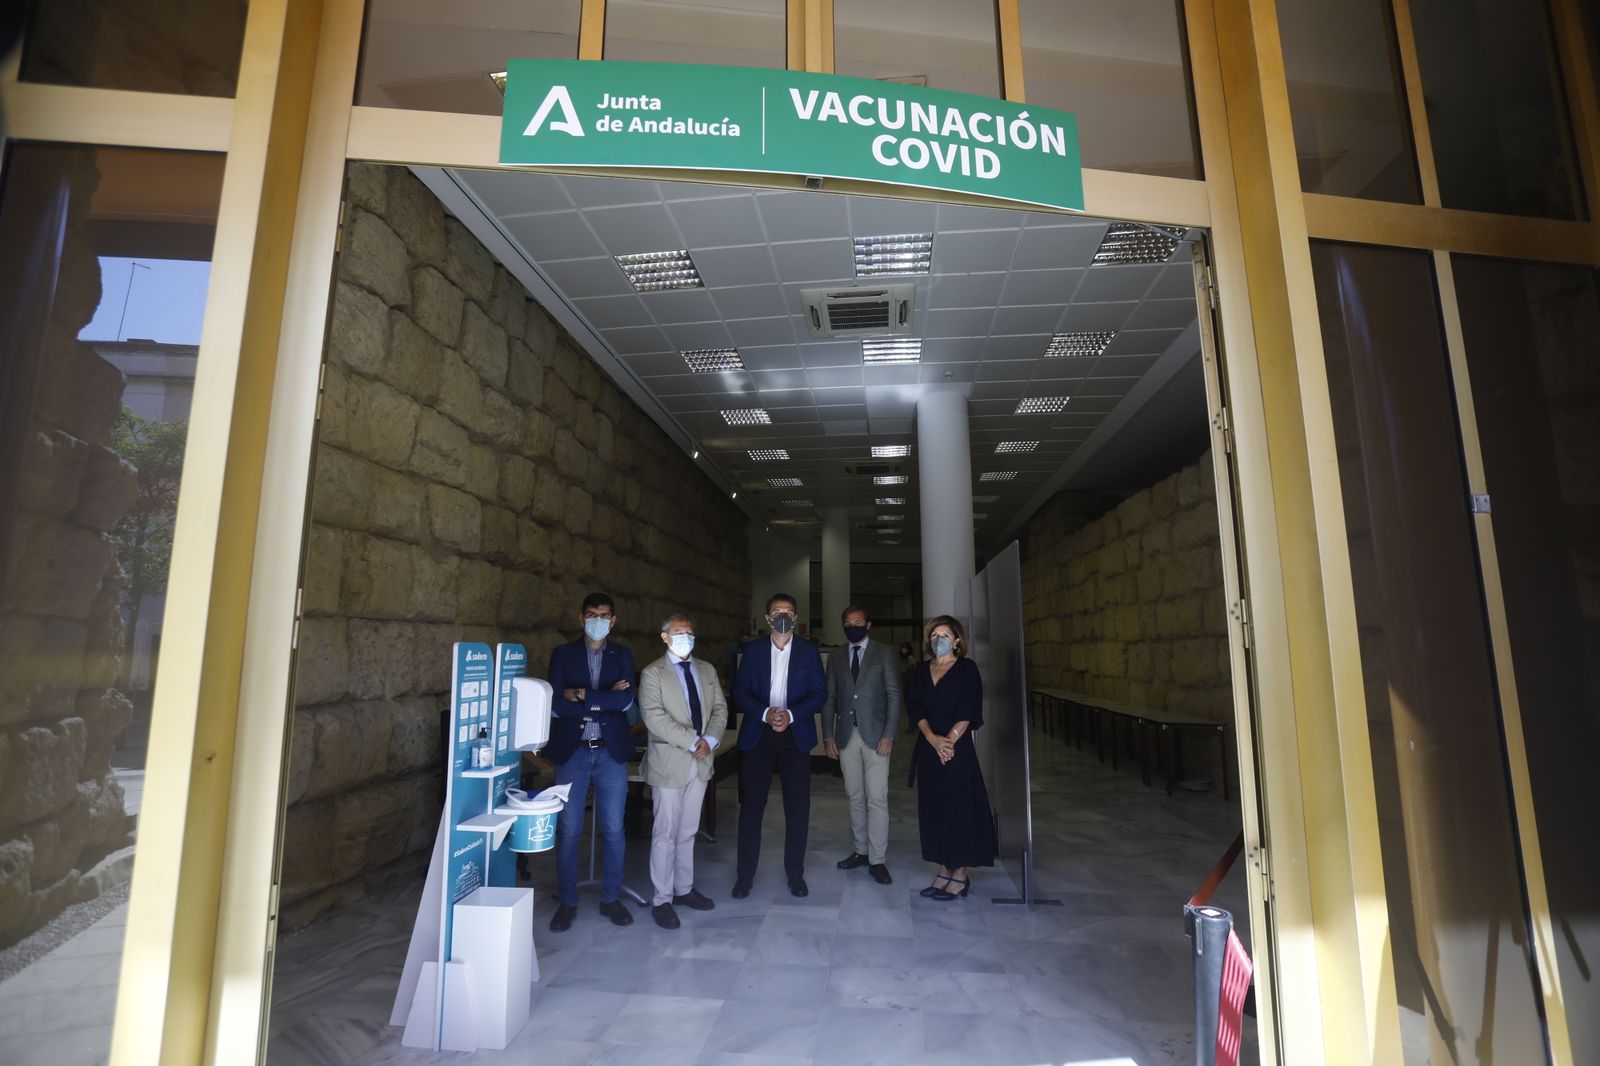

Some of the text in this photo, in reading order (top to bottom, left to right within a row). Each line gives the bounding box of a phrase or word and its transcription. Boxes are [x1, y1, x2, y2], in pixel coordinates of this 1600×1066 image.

[595, 92, 662, 111] Junta
[595, 115, 741, 137] de Andalucía
[788, 86, 1067, 157] VACUNACIÓN
[871, 133, 1002, 180] COVID
